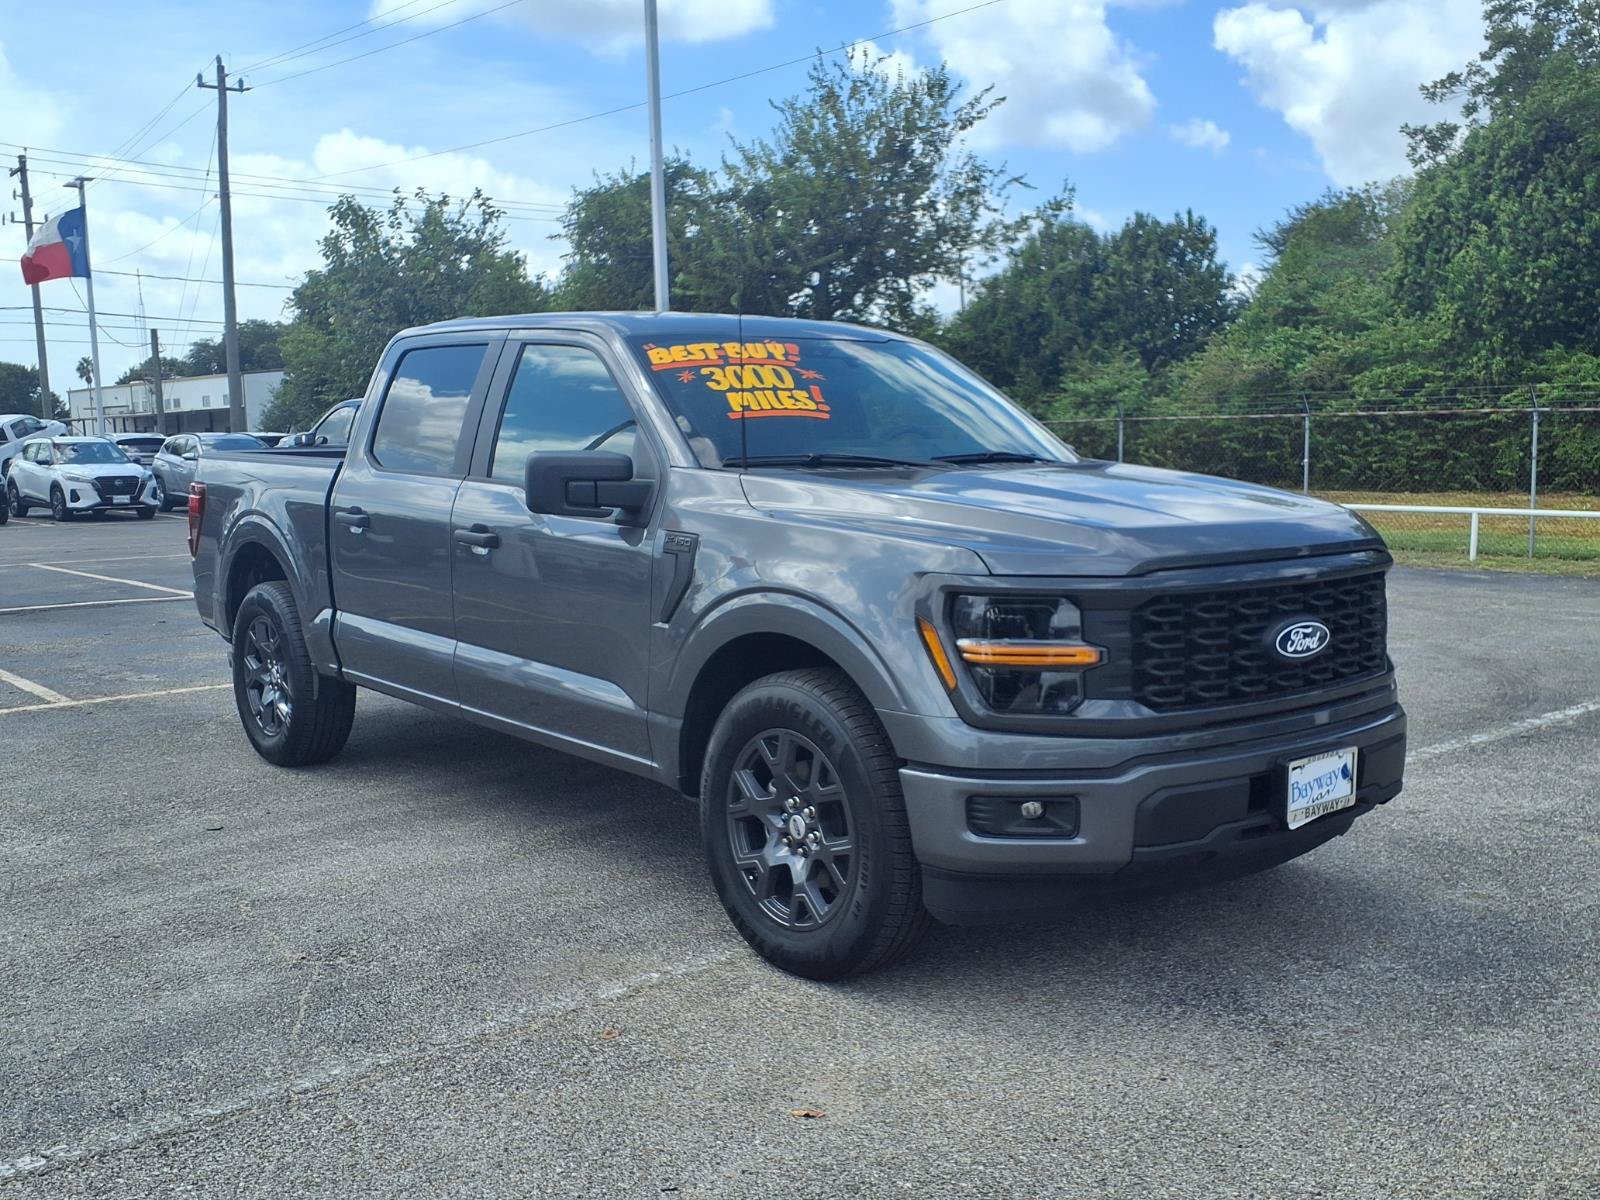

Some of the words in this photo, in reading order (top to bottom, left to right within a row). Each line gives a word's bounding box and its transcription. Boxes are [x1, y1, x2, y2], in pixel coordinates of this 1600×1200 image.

[700, 365, 795, 391] 3000
[726, 385, 832, 412] MILES!
[1286, 627, 1321, 653] Ford
[1291, 766, 1341, 806] Bayway
[1304, 799, 1340, 819] BAYWAY
